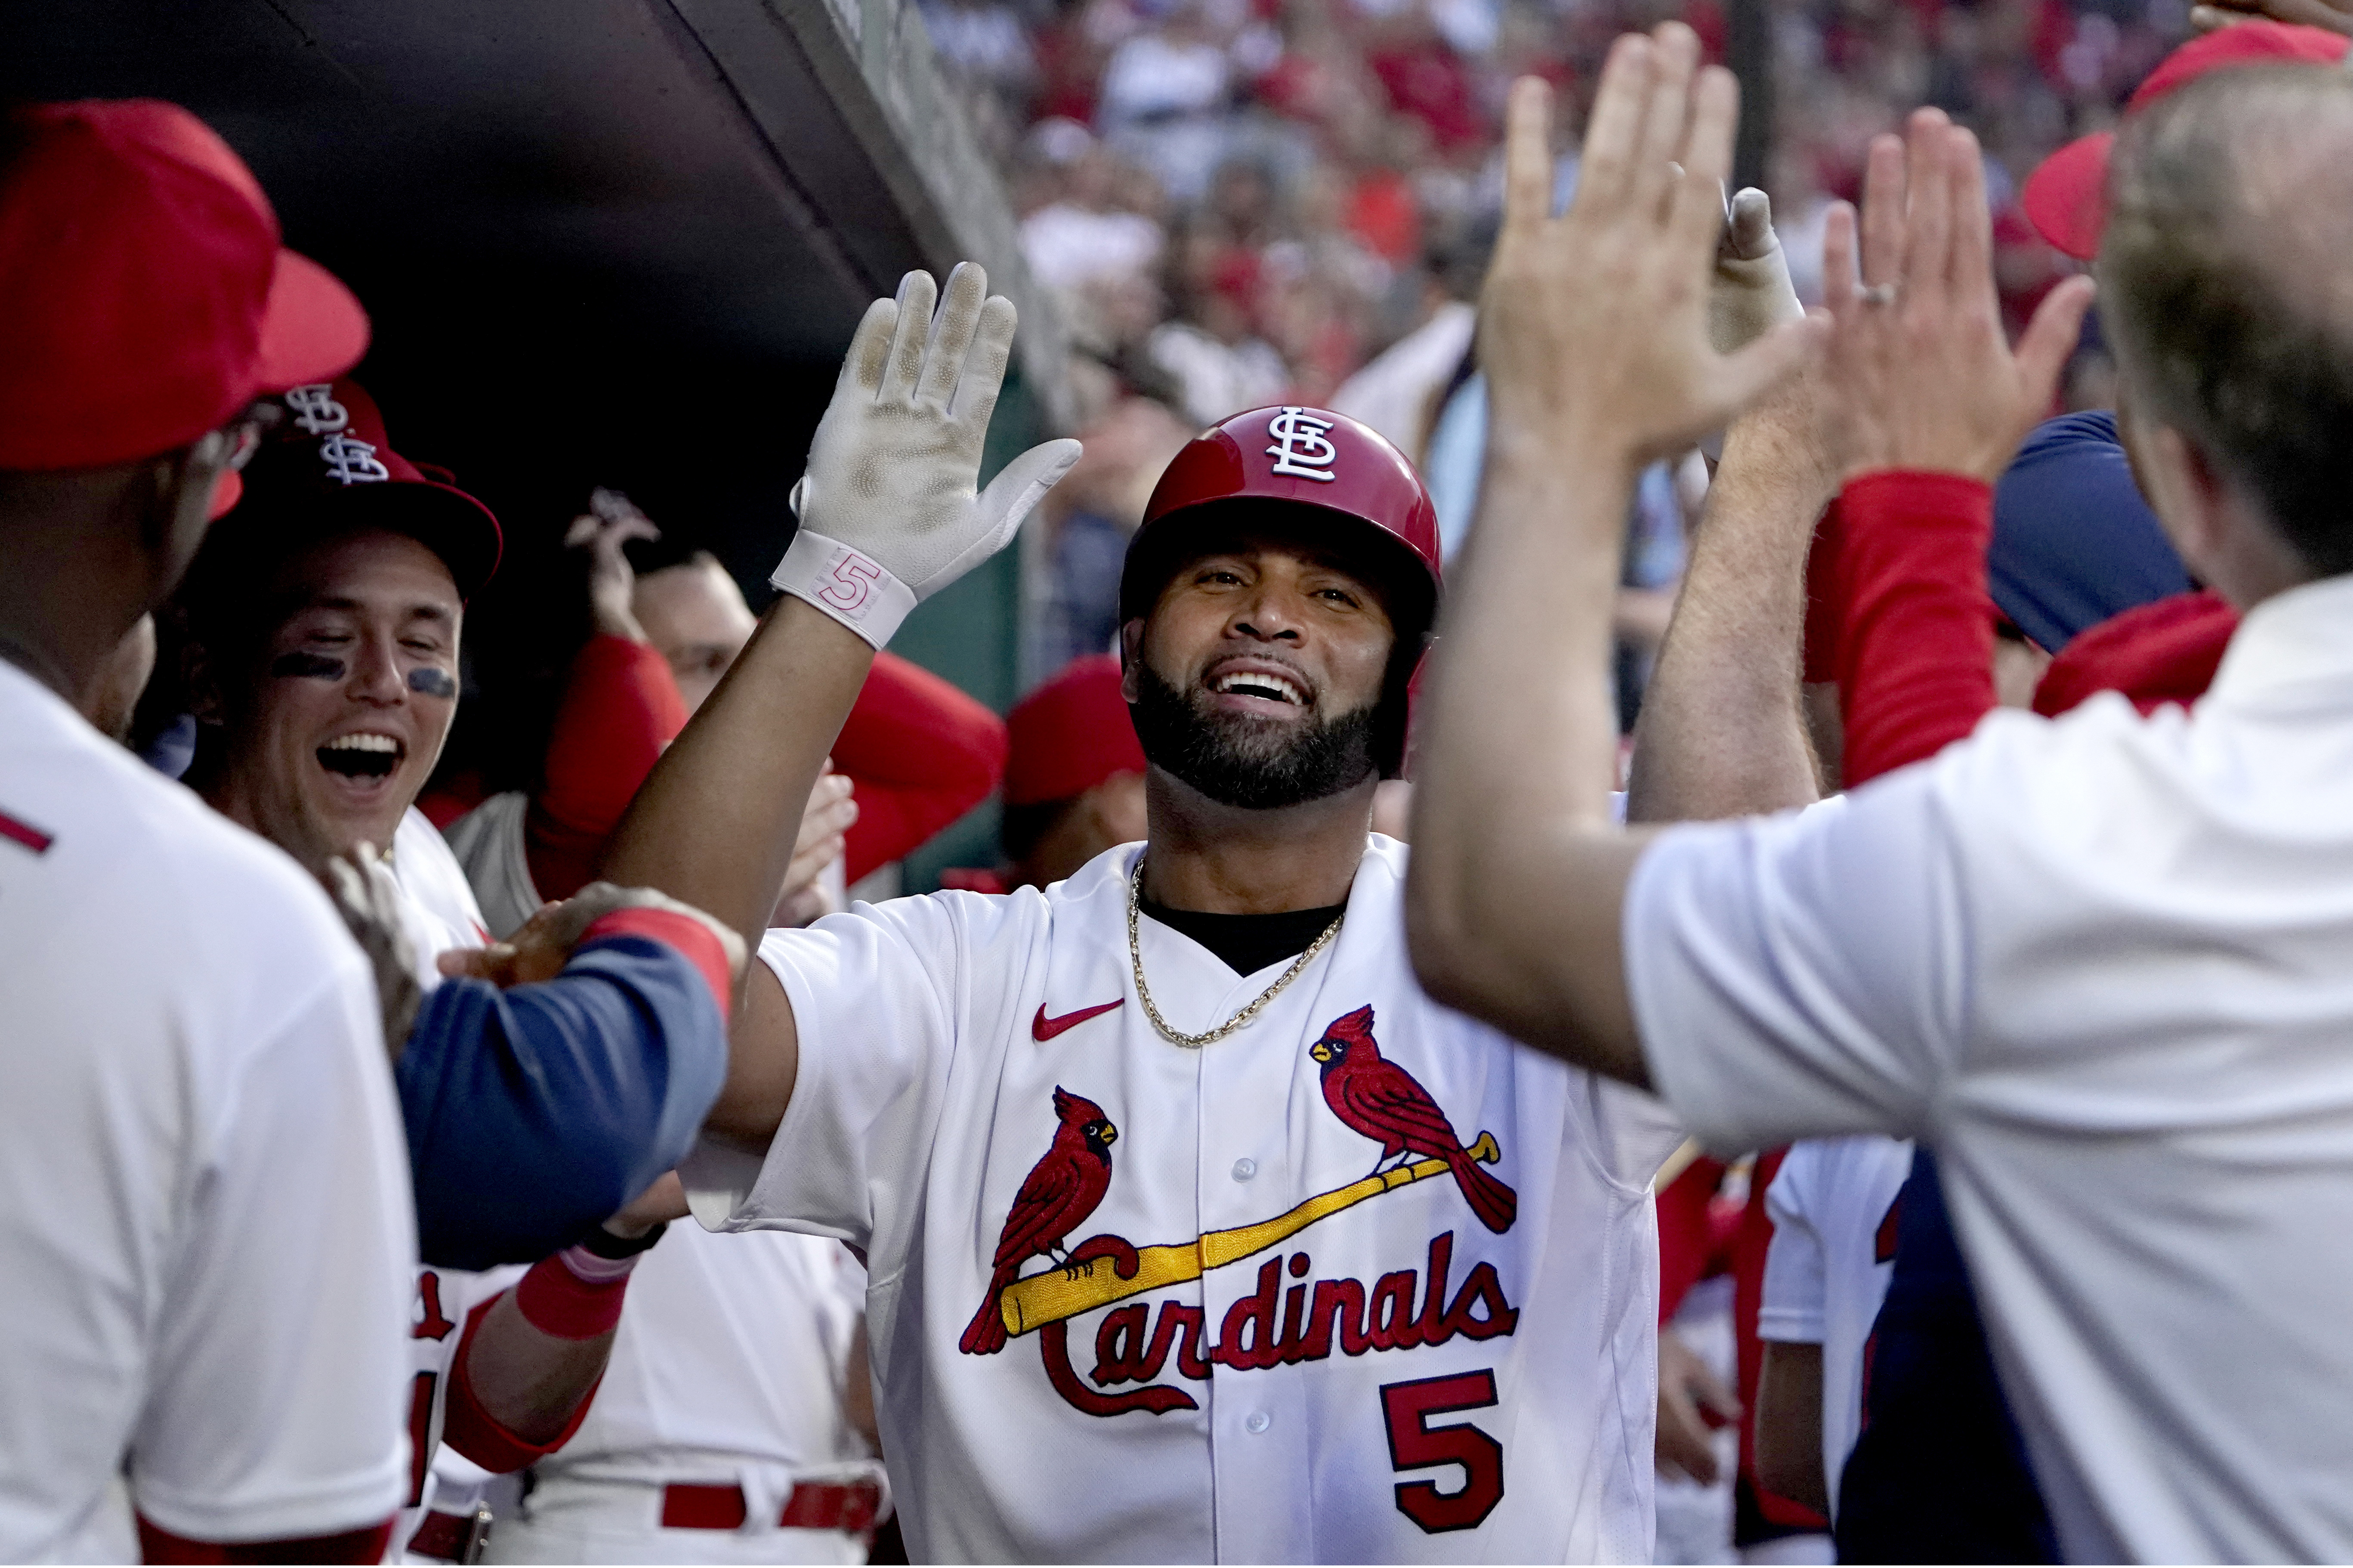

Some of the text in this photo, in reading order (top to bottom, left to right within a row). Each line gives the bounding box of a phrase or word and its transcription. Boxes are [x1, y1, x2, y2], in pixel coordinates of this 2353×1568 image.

[819, 553, 880, 610] 5
[1037, 1232, 1520, 1417] Cardinals
[1379, 1367, 1504, 1534] 5
